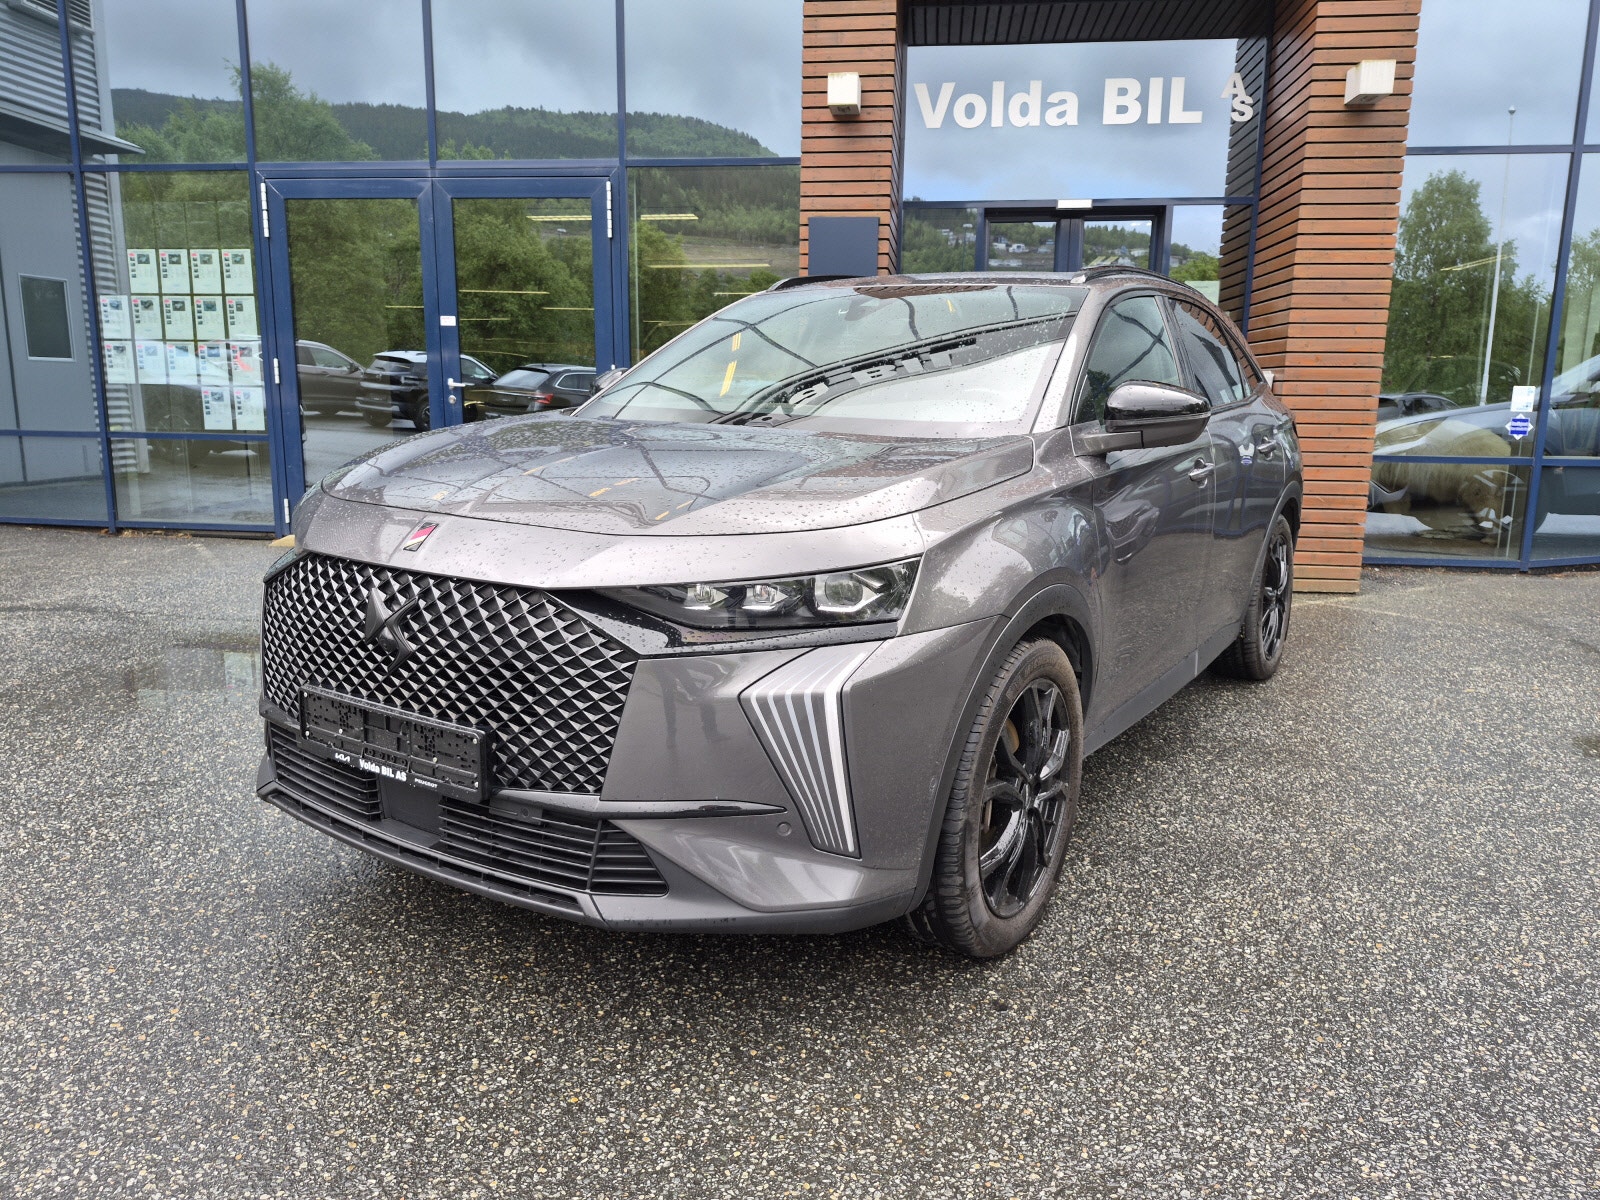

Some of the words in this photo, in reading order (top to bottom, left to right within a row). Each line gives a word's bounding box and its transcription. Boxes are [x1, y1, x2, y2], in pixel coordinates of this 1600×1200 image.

[913, 80, 1079, 129] Volda
[1102, 76, 1203, 126] BIL
[359, 759, 380, 774] Volda
[381, 765, 395, 778] BIL
[395, 770, 407, 782] AS
